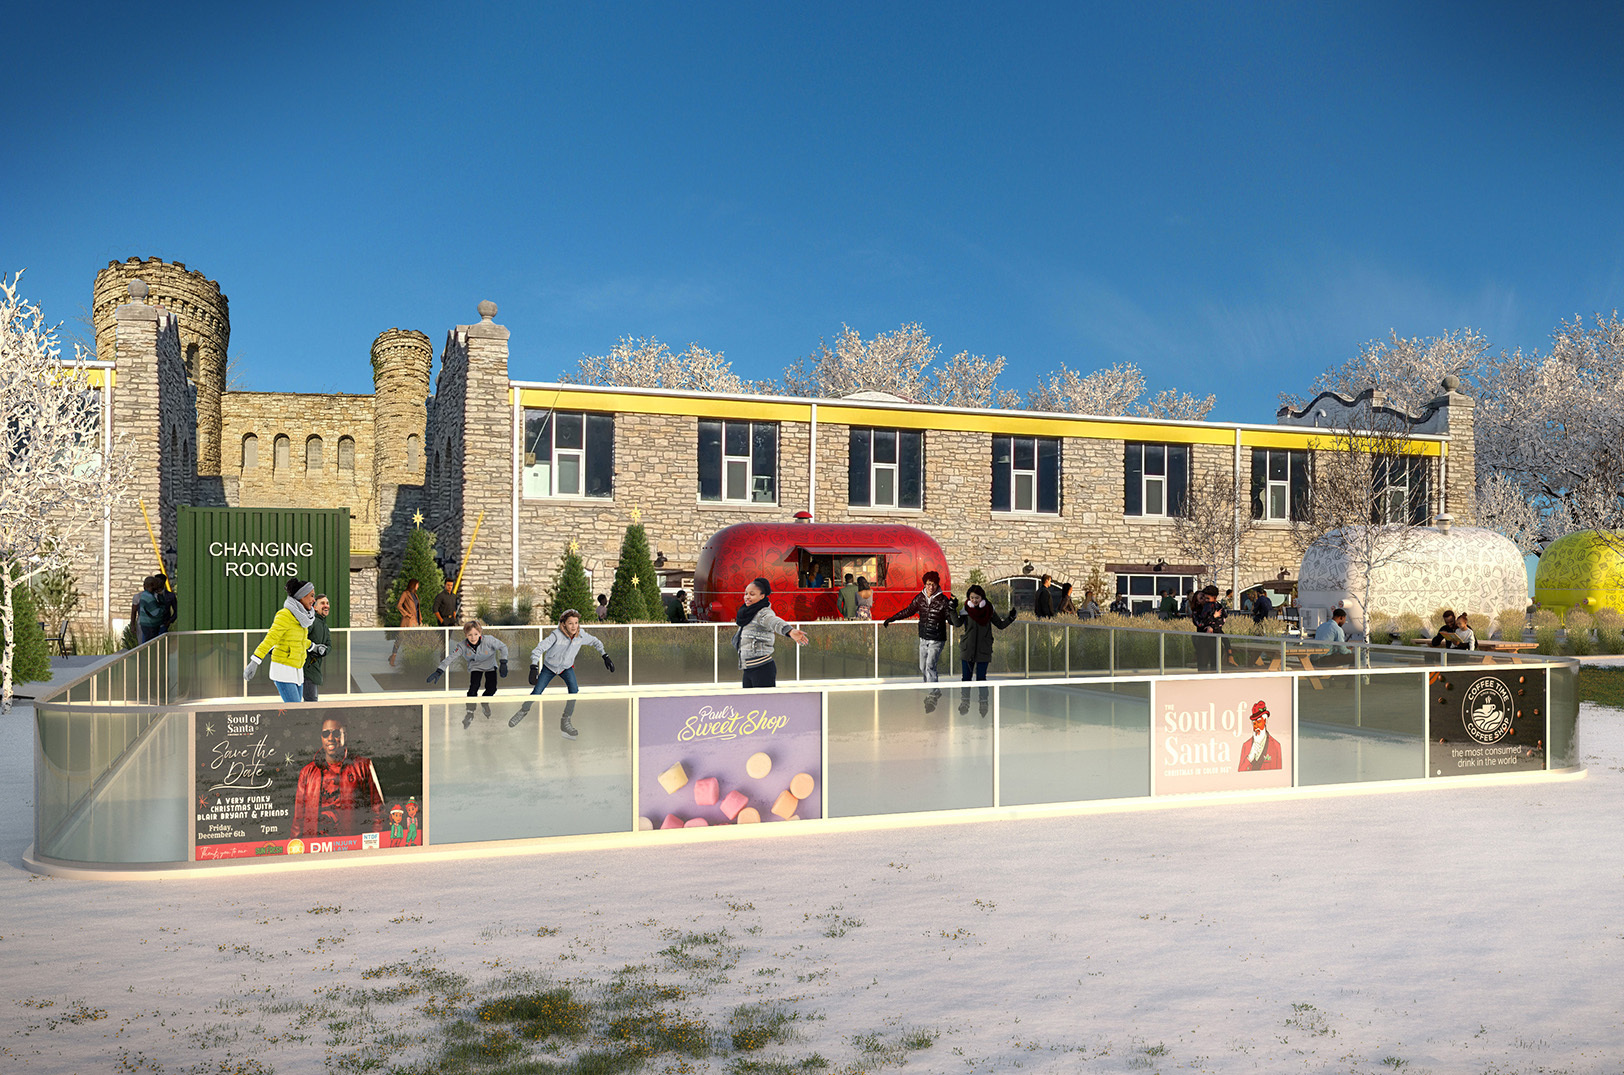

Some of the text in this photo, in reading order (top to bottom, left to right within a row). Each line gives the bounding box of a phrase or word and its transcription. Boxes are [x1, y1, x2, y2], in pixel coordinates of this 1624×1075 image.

[209, 542, 314, 557] CHANGING
[225, 562, 298, 577] ROOMS
[1468, 680, 1510, 702] COFFEE TIME
[250, 714, 261, 725] of
[698, 706, 735, 722] Paul's
[1221, 700, 1248, 738] of
[227, 724, 254, 733] Santa
[678, 710, 790, 742] Sweet Shop
[1467, 718, 1509, 742] COFFEE SHOP
[210, 734, 276, 770] Save the
[1164, 736, 1232, 766] Santa
[1452, 745, 1522, 758] the most consumed
[1458, 756, 1518, 768] drink in the world
[224, 760, 264, 786] Date
[225, 796, 244, 804] VERY
[210, 804, 252, 812] CHRISTMAS
[220, 812, 248, 820] BRYANT
[251, 810, 258, 818] &
[260, 809, 289, 818] FRIENDS
[260, 824, 278, 834] 7pm
[266, 845, 284, 854] FRESH
[310, 842, 332, 853] DM
